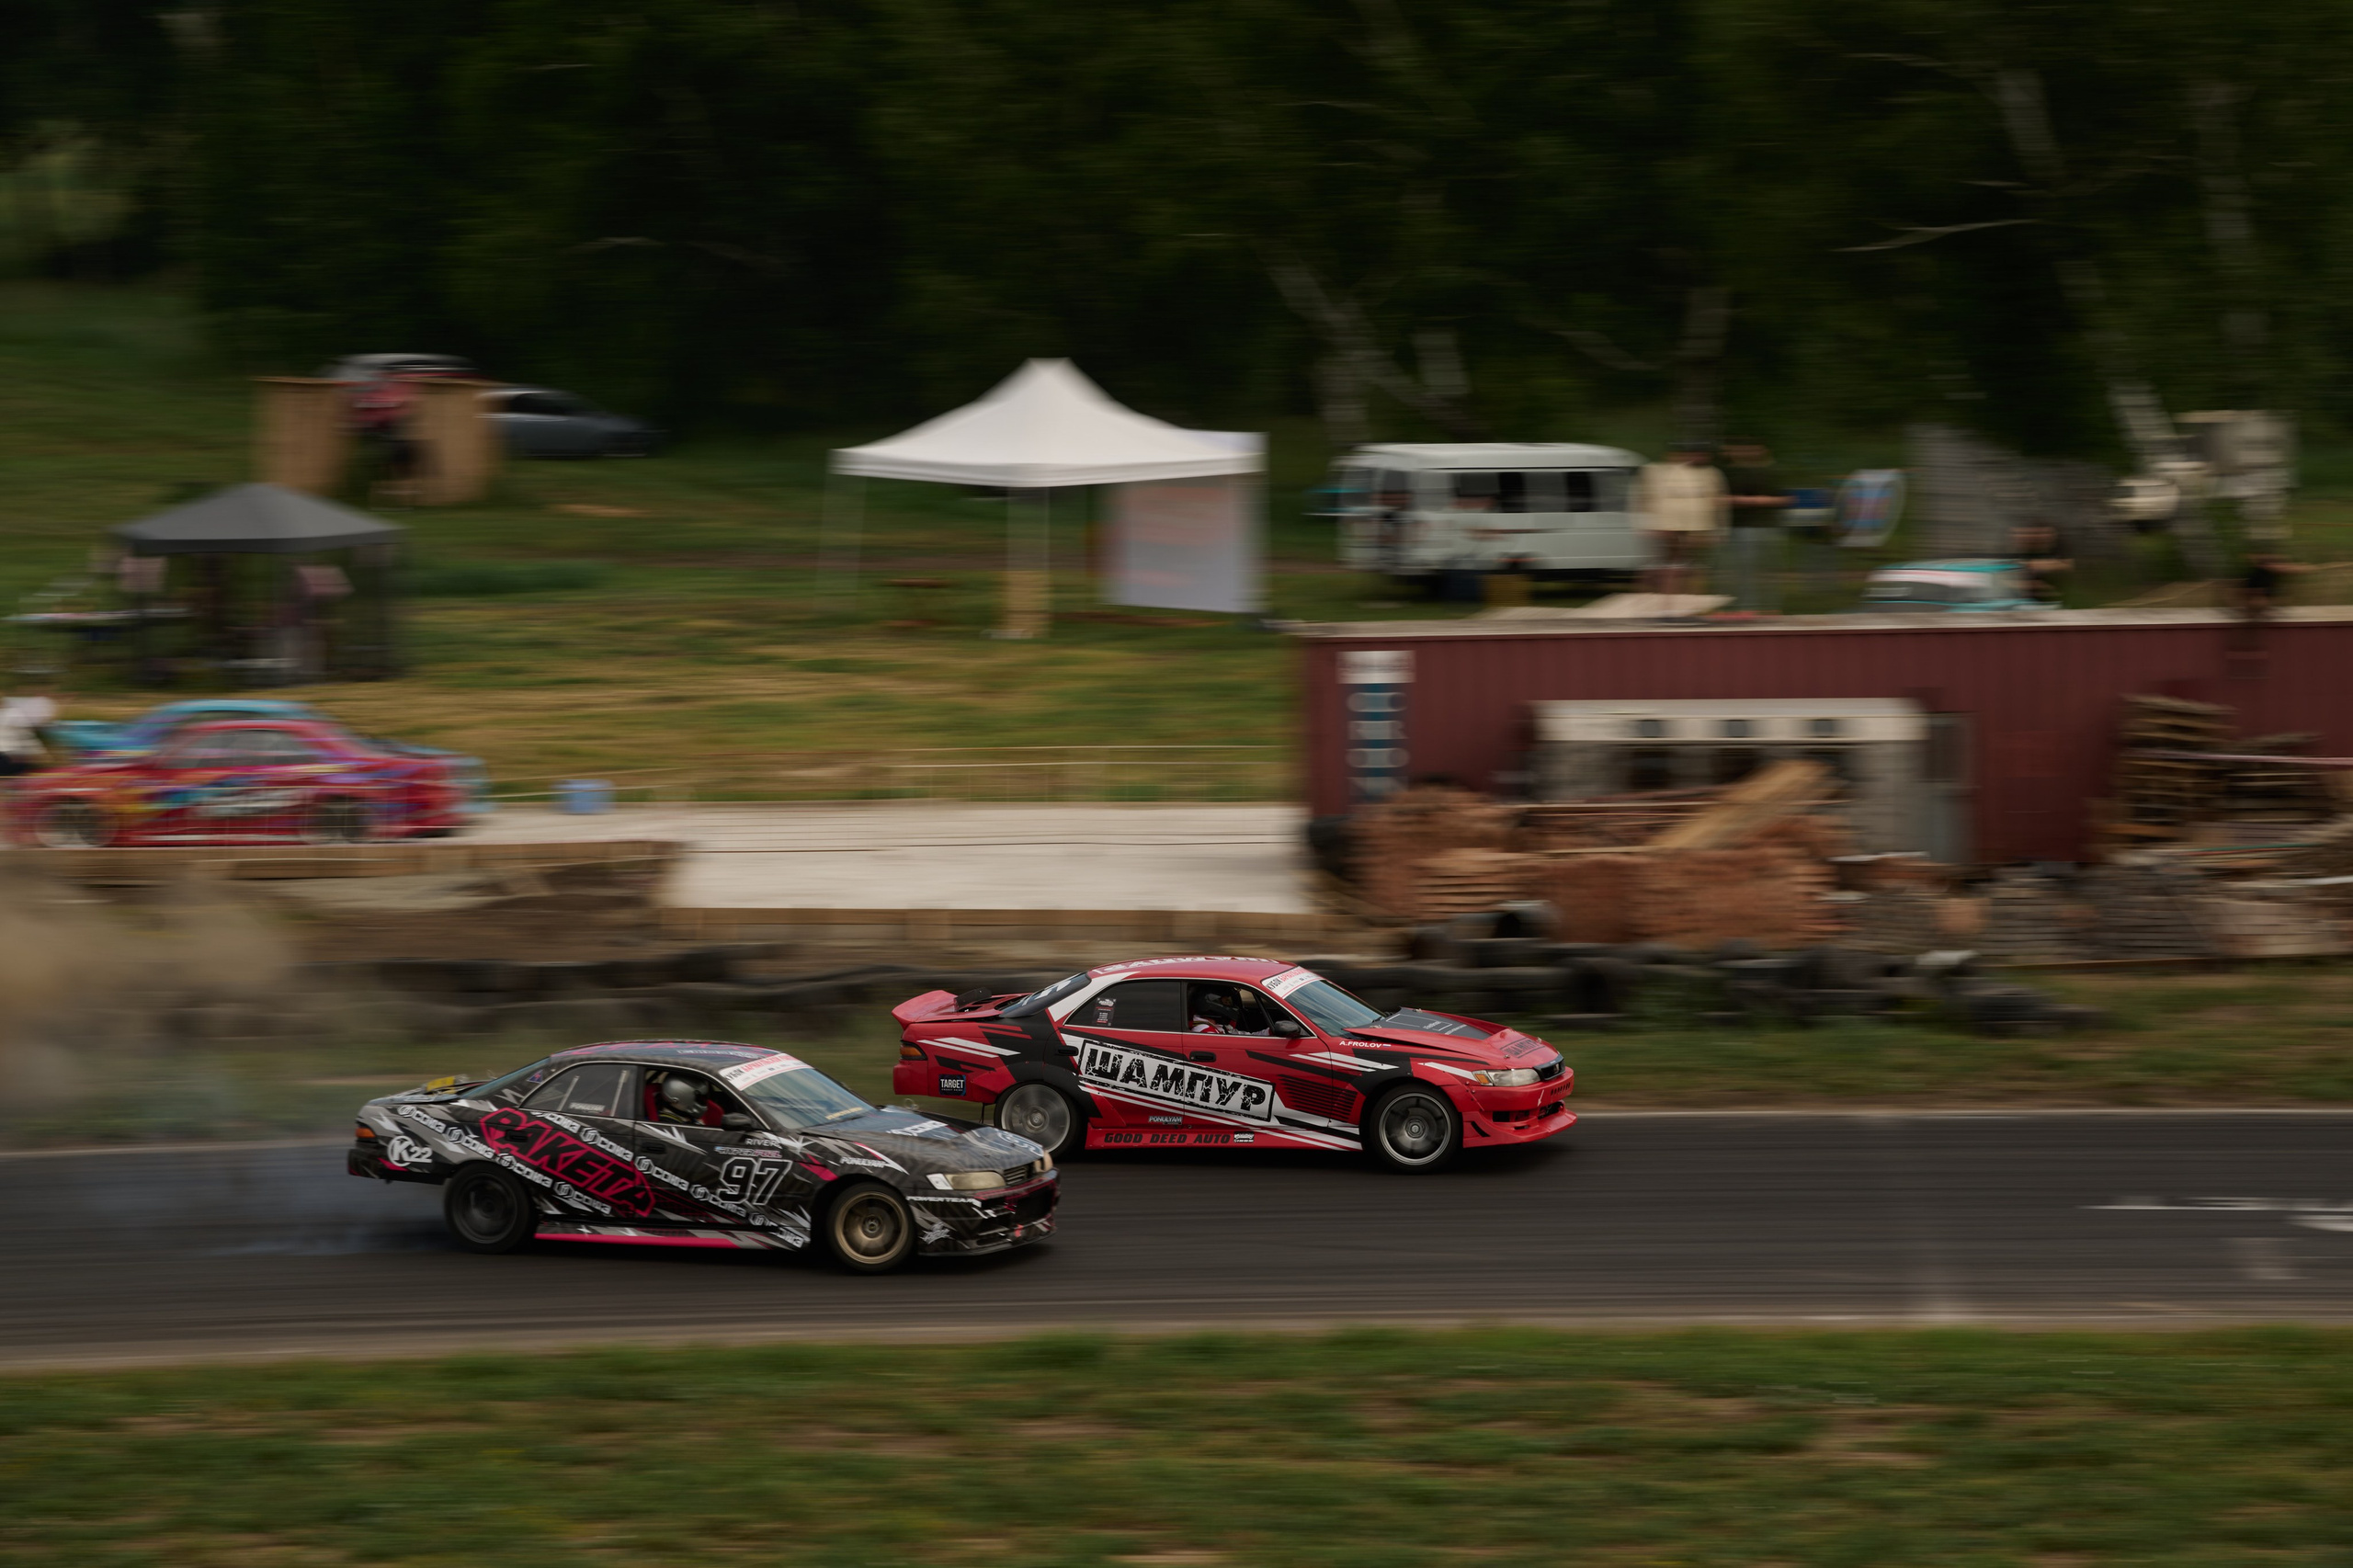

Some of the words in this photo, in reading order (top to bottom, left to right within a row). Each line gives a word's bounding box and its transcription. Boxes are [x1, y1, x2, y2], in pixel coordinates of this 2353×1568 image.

[940, 1079, 964, 1088] TARGET
[1086, 1049, 1266, 1111] ШАМПУР
[388, 1135, 433, 1166] K22
[716, 1156, 793, 1206] 97
